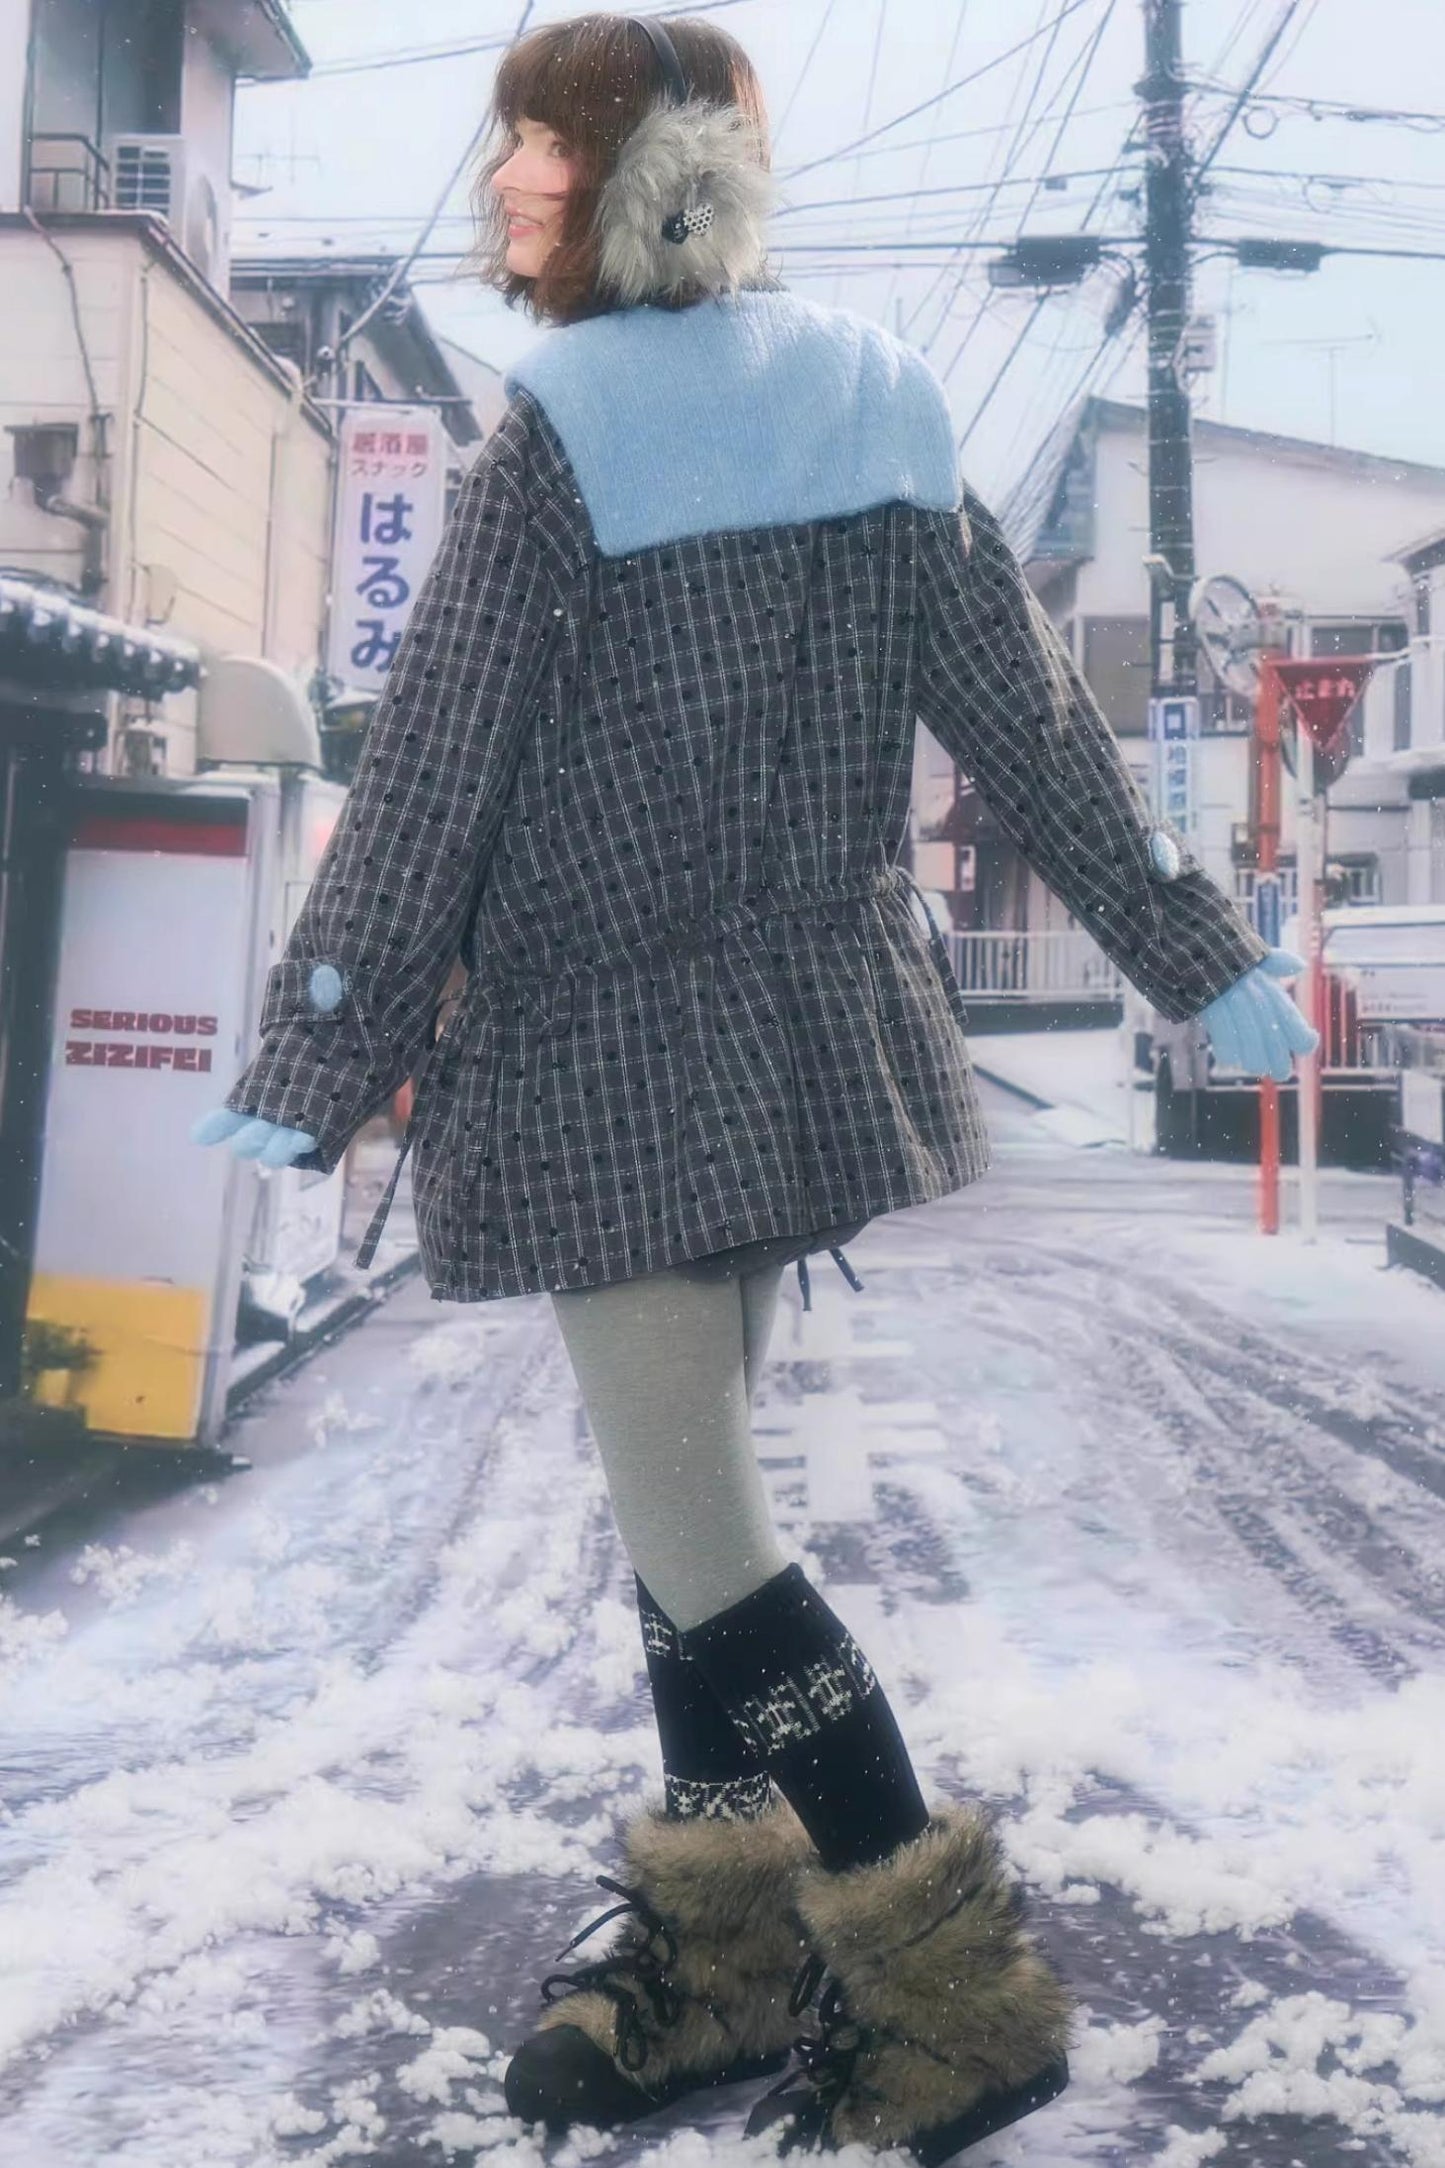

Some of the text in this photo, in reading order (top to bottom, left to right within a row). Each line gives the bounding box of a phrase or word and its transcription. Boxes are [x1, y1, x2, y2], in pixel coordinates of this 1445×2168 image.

[352, 459, 427, 478] スナック
[350, 492, 413, 672] はるみ
[69, 1009, 218, 1036] SERIOUS
[65, 1041, 212, 1072] ZIZIFEI
